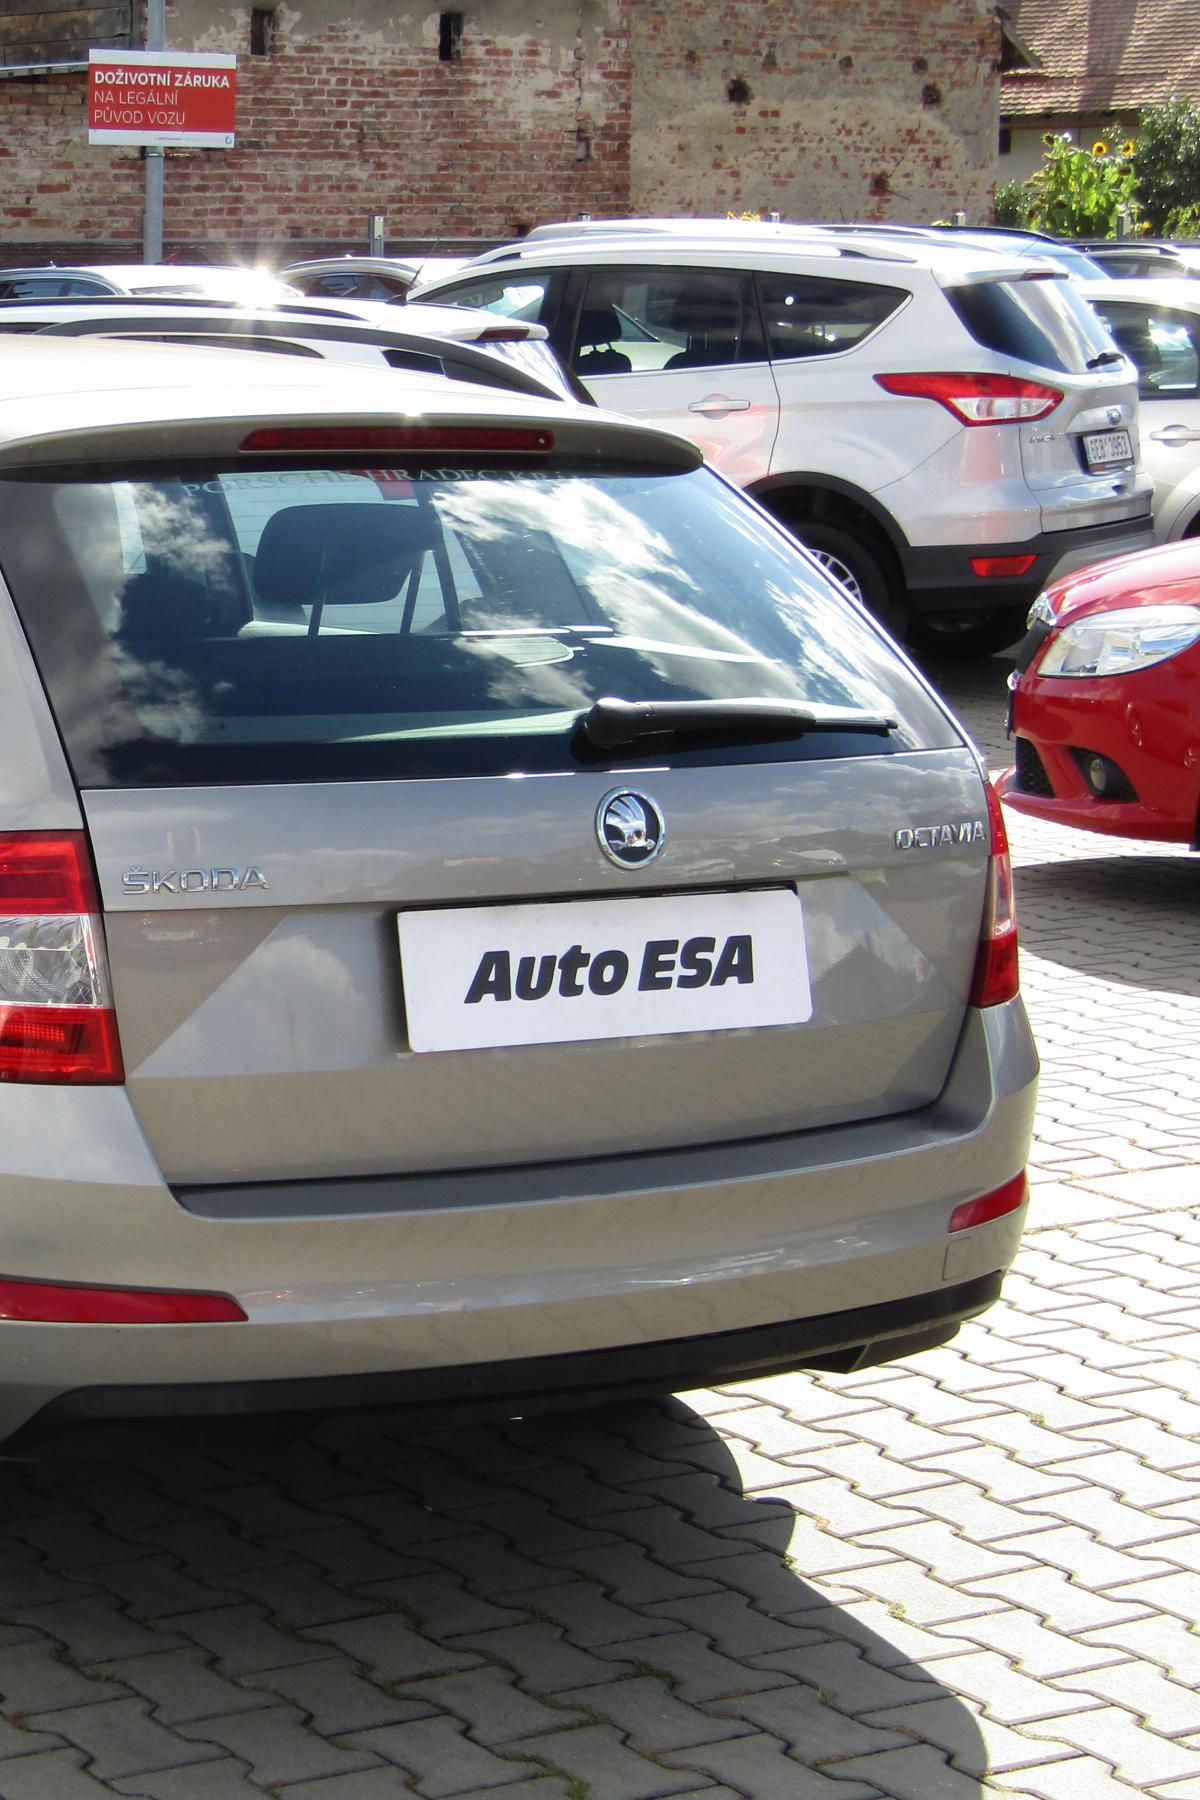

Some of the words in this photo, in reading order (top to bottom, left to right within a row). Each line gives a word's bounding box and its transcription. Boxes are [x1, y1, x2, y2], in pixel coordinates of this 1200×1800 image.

[94, 69, 171, 86] DOŽIVOTNÍ
[174, 71, 230, 88] ZÁRUKA
[94, 91, 114, 103] NA
[119, 90, 178, 106] LEGÁLNÍ
[94, 107, 143, 124] PŮVOD
[148, 111, 185, 125] VOZU
[182, 470, 358, 497] PORSCHE
[895, 820, 986, 849] OCTAVIA
[122, 866, 271, 895] ŠKODA
[464, 944, 629, 1004] Auto
[638, 934, 754, 991] ESA
